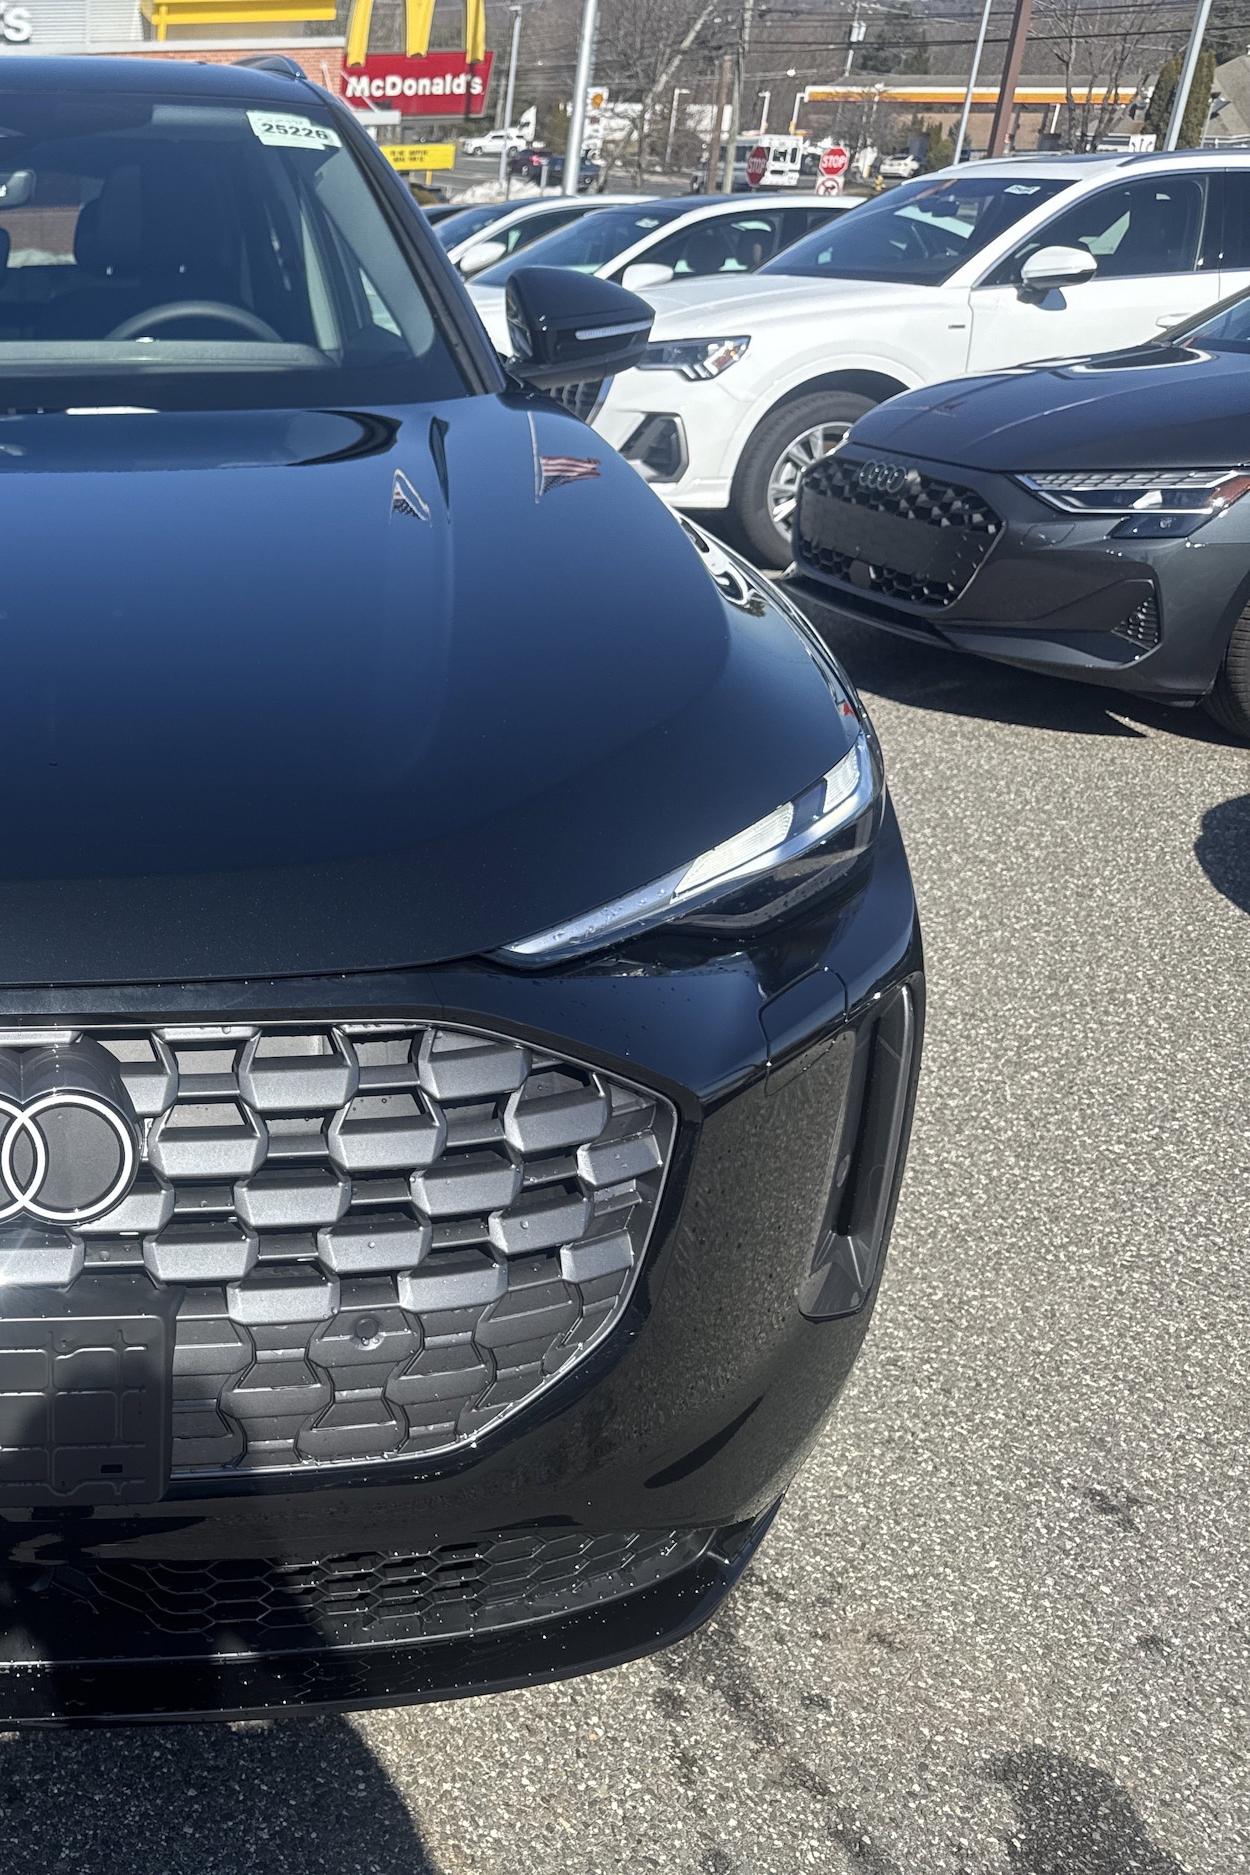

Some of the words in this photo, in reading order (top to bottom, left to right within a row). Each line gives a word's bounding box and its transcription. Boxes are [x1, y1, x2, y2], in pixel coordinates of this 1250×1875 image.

[345, 73, 484, 98] McDonald's
[261, 122, 328, 140] 25226
[748, 157, 766, 174] STOP
[821, 154, 847, 168] STOP
